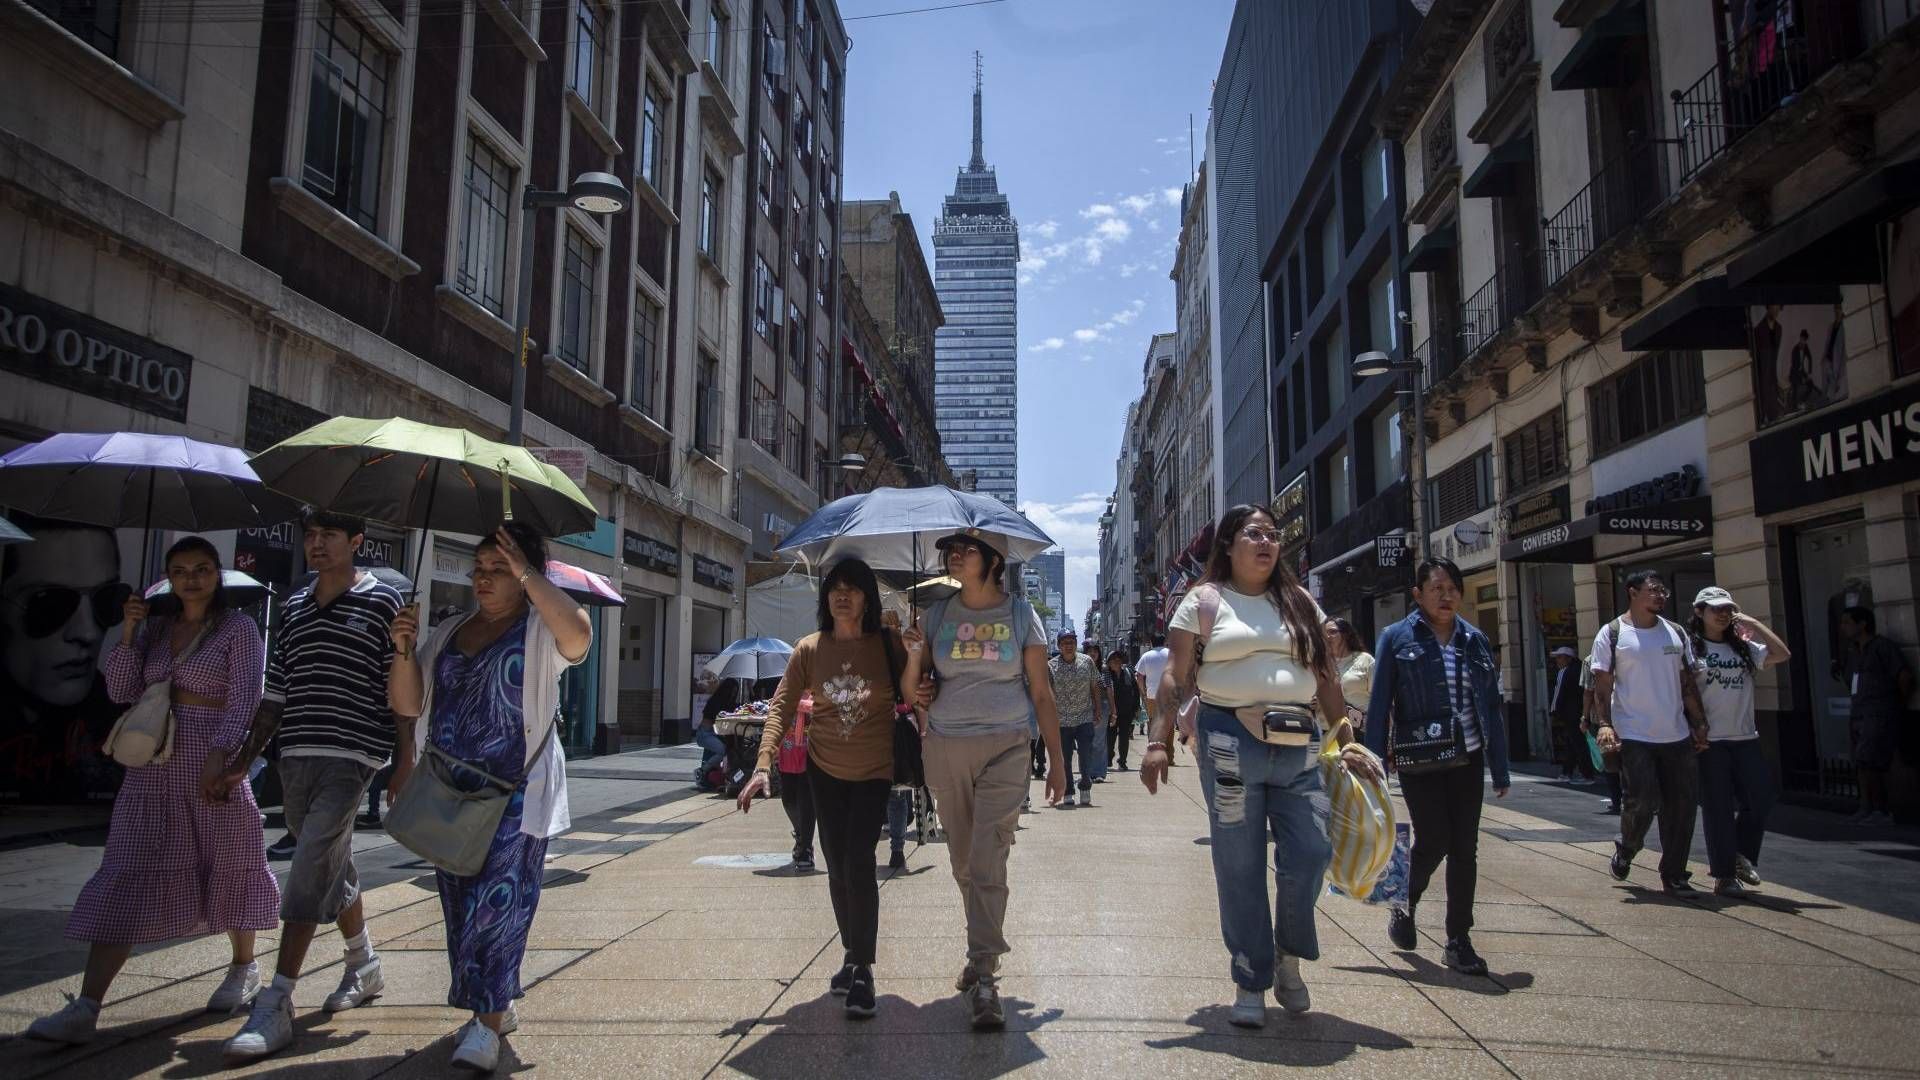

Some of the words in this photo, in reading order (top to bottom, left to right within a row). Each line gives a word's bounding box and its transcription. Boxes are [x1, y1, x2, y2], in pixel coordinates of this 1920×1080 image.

[938, 226, 1013, 234] LATINOAMERICANA
[56, 328, 185, 401] OPTICO
[1802, 401, 1920, 482] MEN'S
[1609, 518, 1689, 531] CONVERSE
[1380, 538, 1400, 548] INN
[1522, 528, 1562, 552] CONVERSE
[357, 539, 393, 562] URATI
[1381, 548, 1406, 557] VICT
[1382, 558, 1398, 567] US
[941, 622, 1010, 641] GOOD
[938, 640, 1014, 661] VIBES
